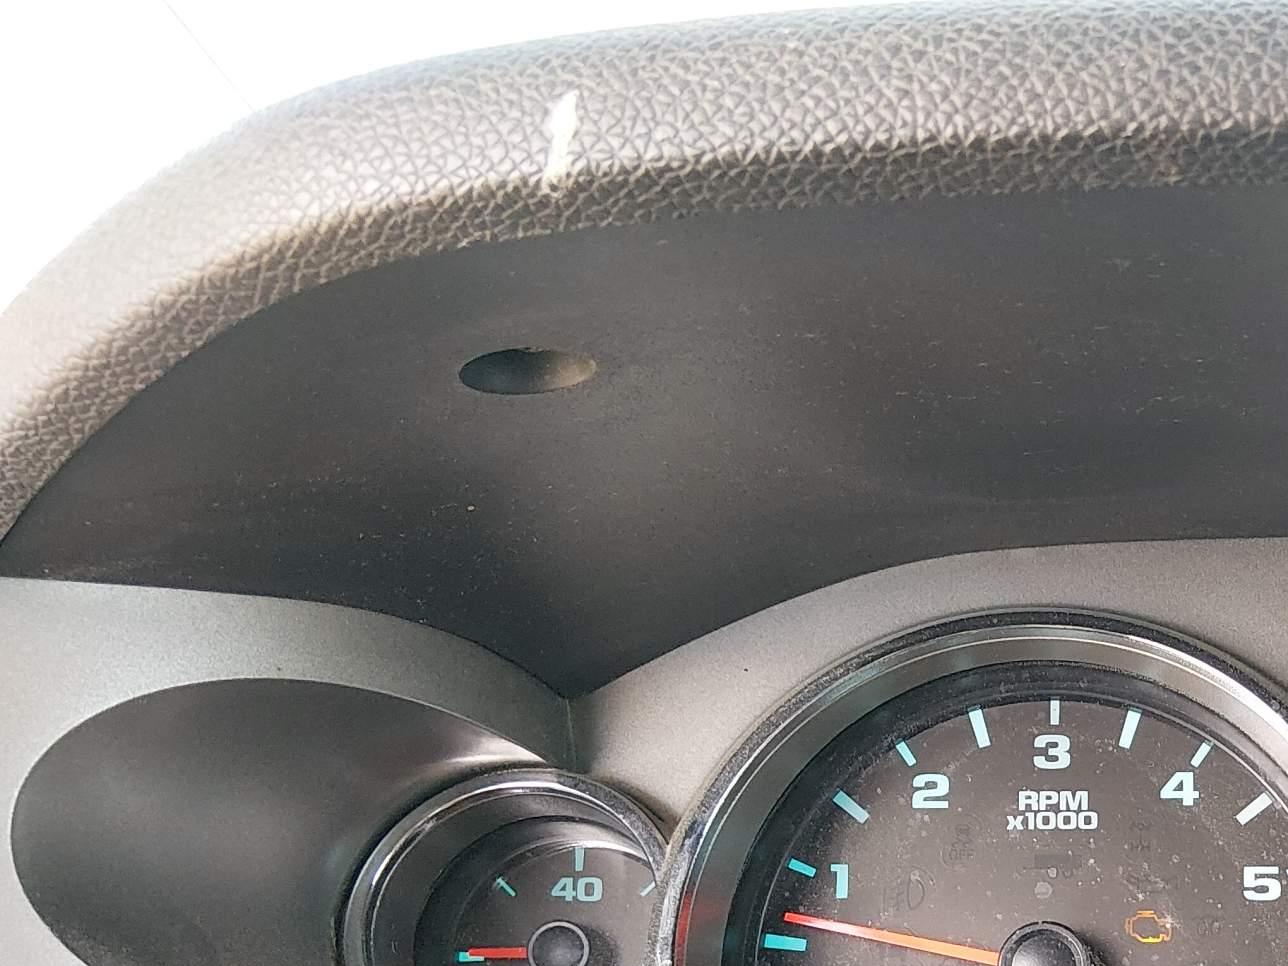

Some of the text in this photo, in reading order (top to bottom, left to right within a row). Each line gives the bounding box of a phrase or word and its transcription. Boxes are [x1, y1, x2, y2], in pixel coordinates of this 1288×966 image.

[1034, 735, 1070, 769] 3
[912, 774, 949, 808] 2
[1018, 790, 1089, 811] RPM
[1161, 772, 1199, 805] 4
[1006, 811, 1097, 831] x1000
[552, 877, 602, 901] 40
[831, 864, 848, 898] 1
[1244, 867, 1281, 900] 5
